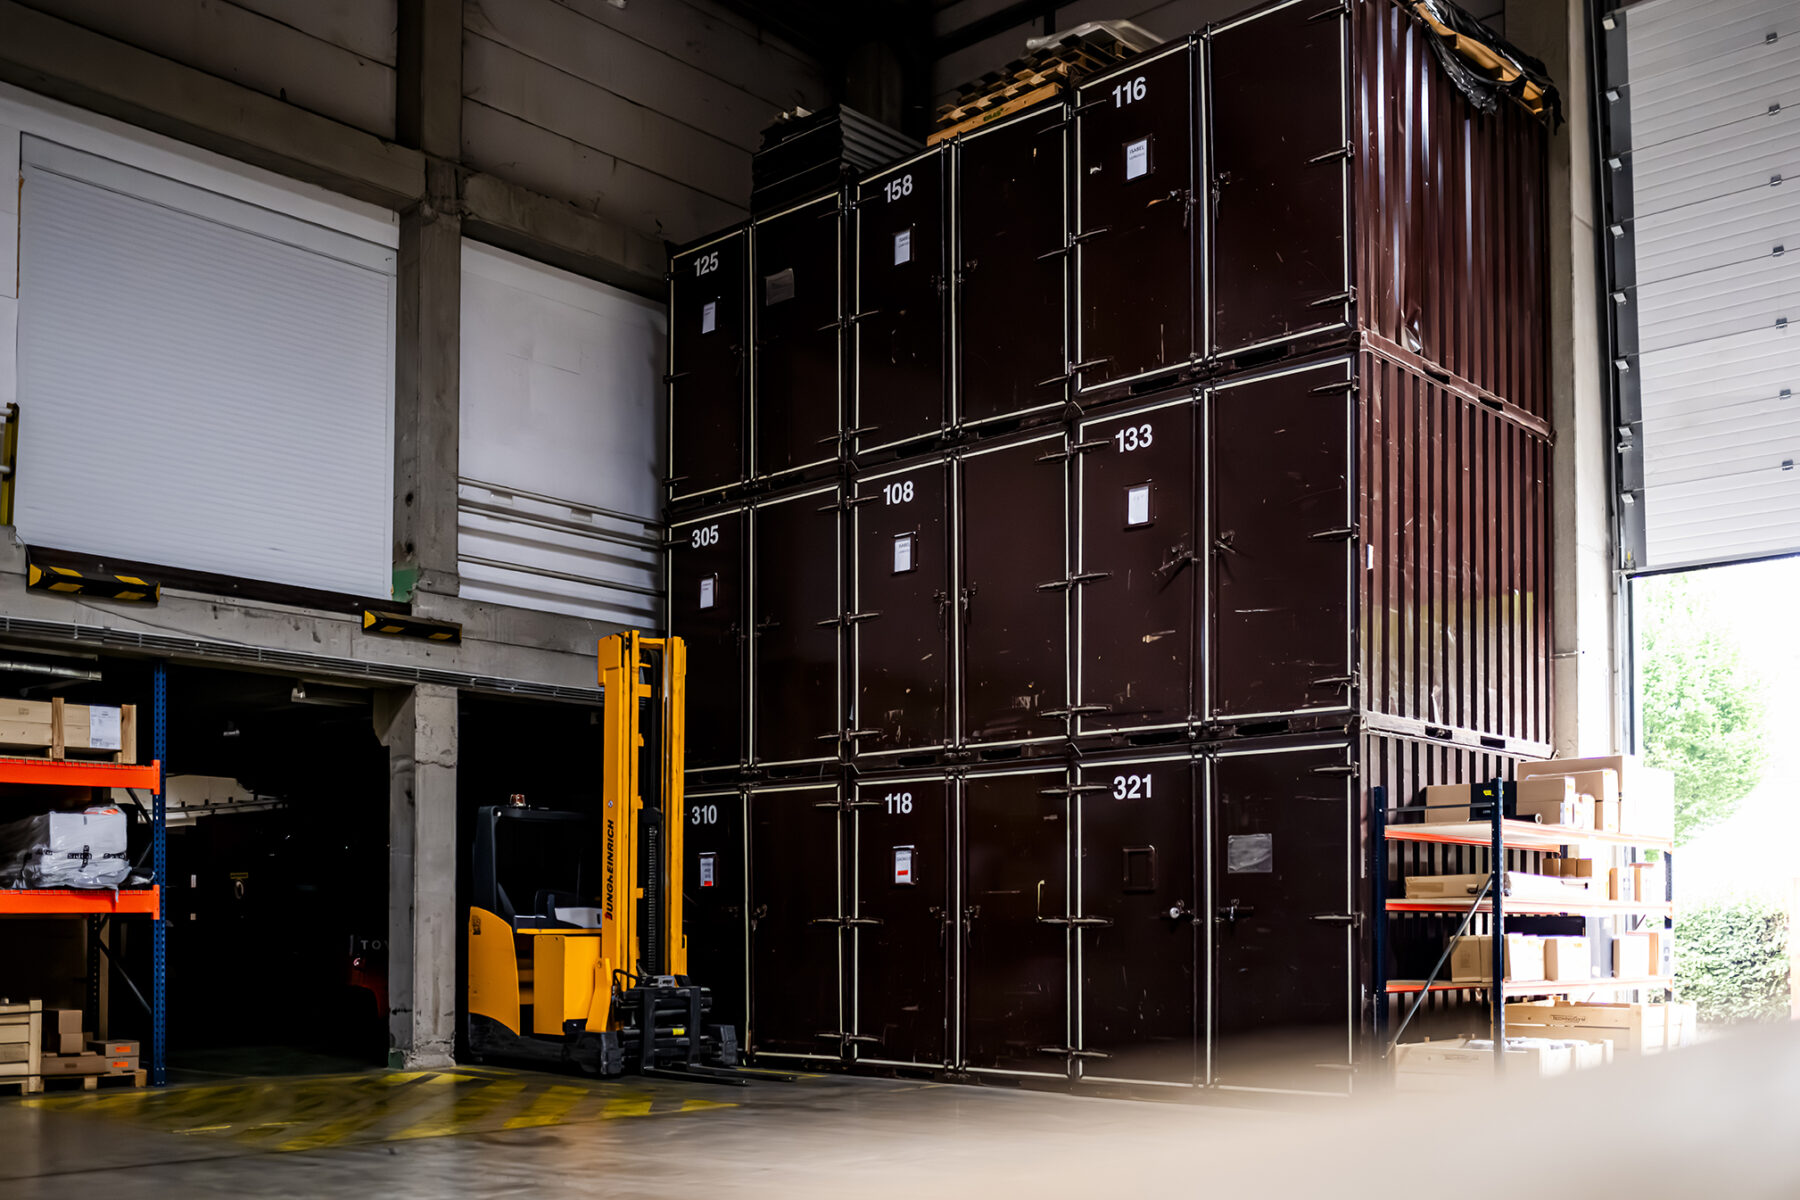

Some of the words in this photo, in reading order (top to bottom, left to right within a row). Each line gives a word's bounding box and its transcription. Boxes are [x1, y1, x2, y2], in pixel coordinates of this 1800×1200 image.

[1111, 77, 1146, 108] 116
[883, 175, 912, 202] 158
[693, 252, 718, 276] 125
[1115, 424, 1152, 453] 133
[883, 481, 914, 505] 108
[692, 525, 718, 548] 305
[1113, 774, 1151, 800] 321
[692, 805, 717, 824] 310
[885, 793, 912, 814] 118
[605, 819, 614, 920] JUNGHEINRICH
